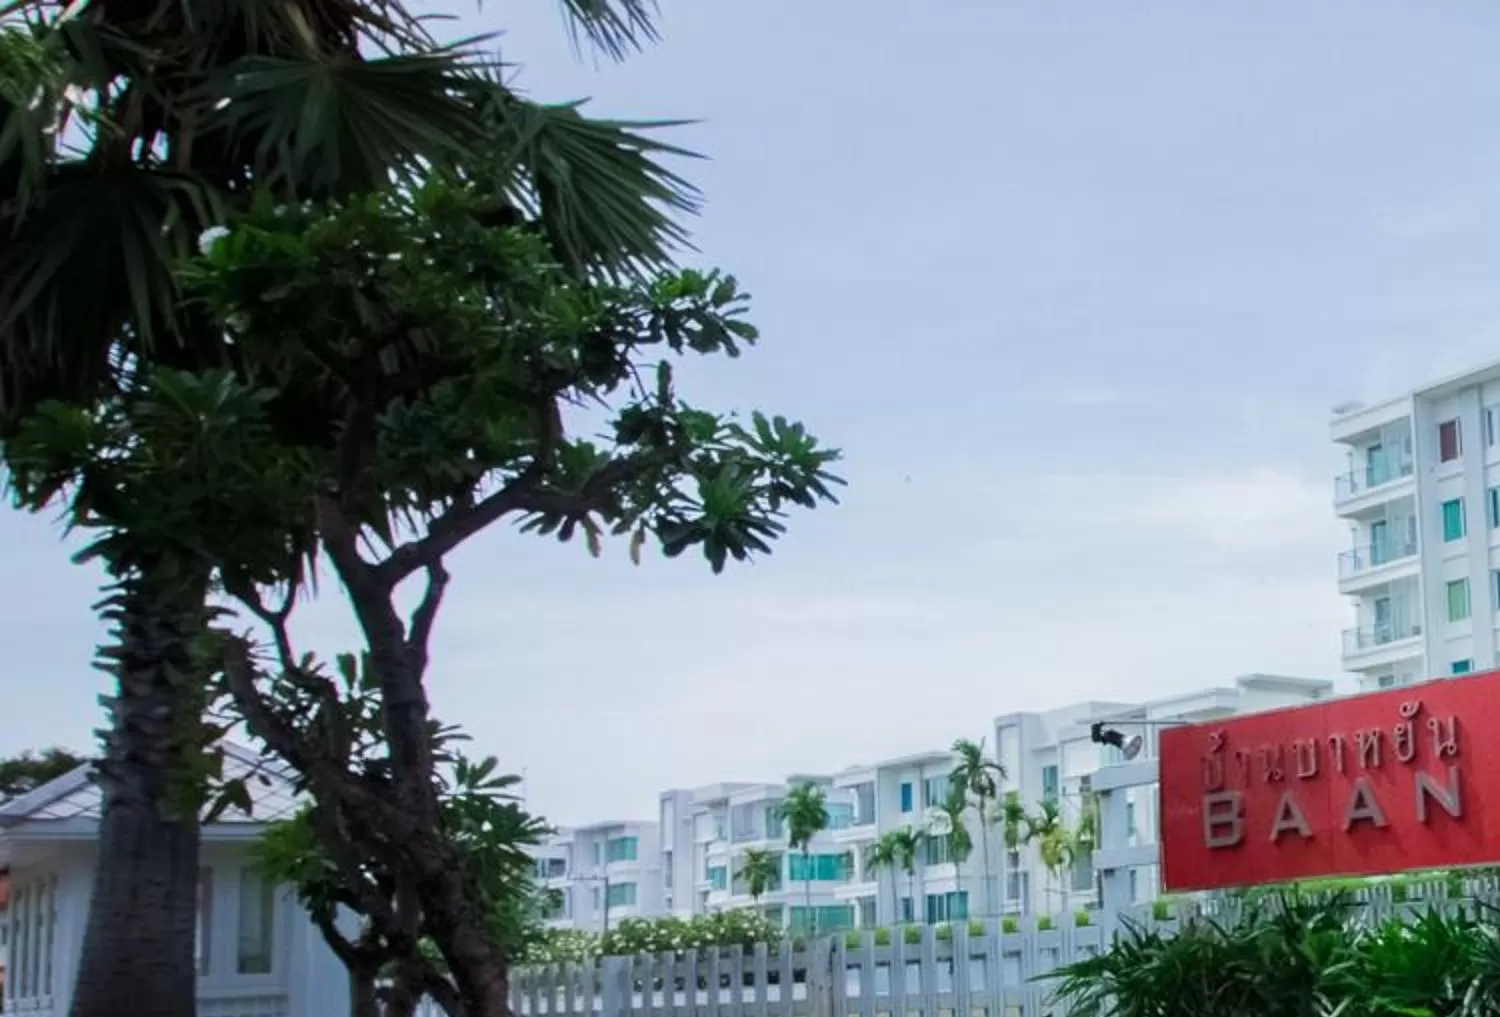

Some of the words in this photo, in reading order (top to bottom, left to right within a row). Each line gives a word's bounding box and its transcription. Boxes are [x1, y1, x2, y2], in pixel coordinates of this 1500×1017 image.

[1202, 700, 1457, 790] บ้านบาหยัน
[1203, 766, 1462, 849] BAAN
